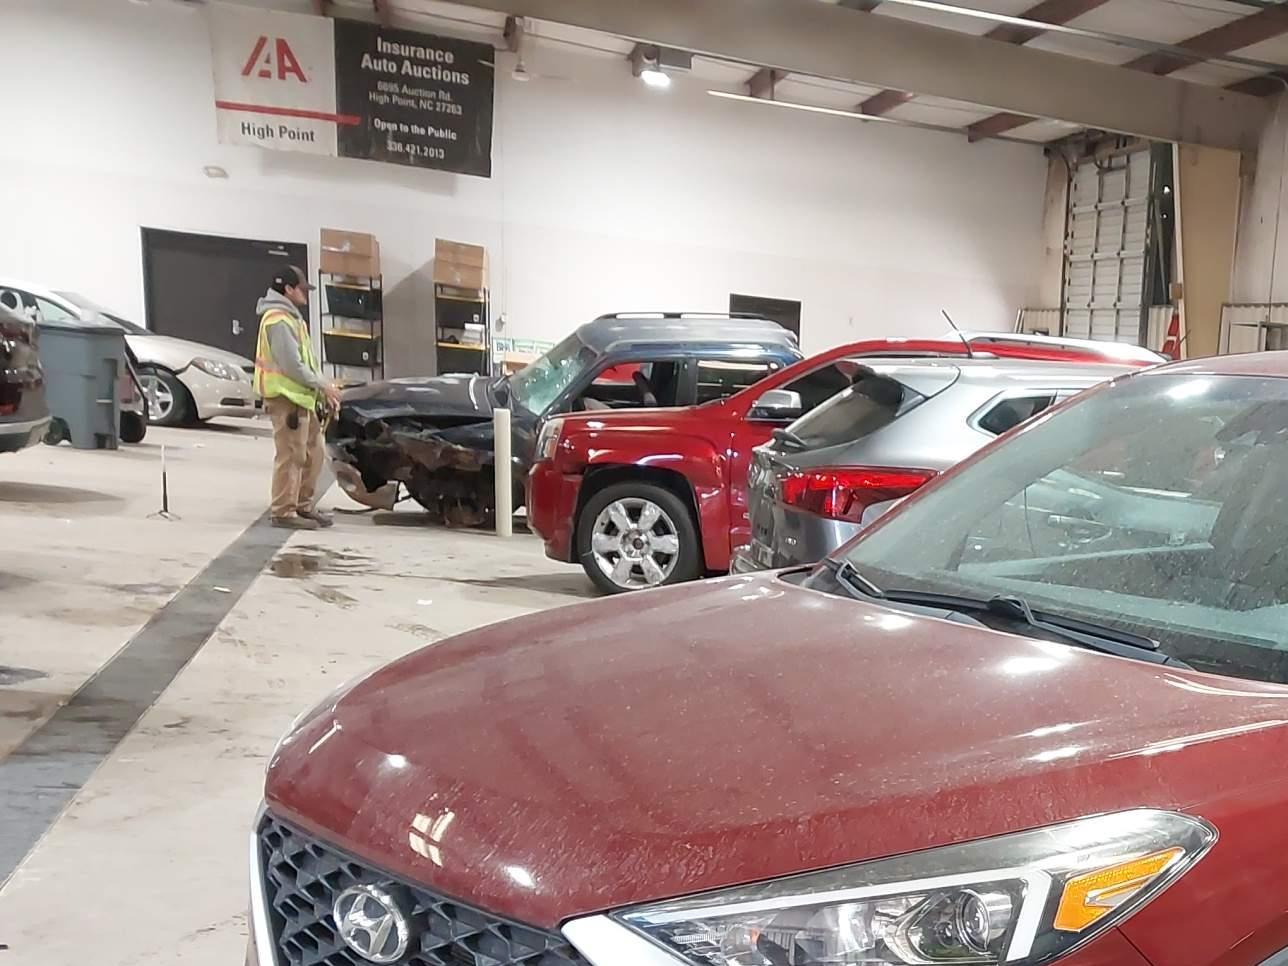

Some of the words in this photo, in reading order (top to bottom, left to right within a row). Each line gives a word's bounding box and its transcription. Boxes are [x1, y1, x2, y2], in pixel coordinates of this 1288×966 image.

[377, 36, 454, 63] Insurance
[361, 53, 398, 73] Auto
[401, 60, 470, 85] Auctions
[368, 91, 390, 105] High
[419, 100, 434, 112] NC
[401, 83, 438, 100] Auction
[241, 121, 275, 140] High
[278, 125, 315, 142] Point
[373, 117, 398, 132] Open
[399, 122, 410, 133] to
[410, 123, 427, 136] the
[427, 125, 458, 141] Public
